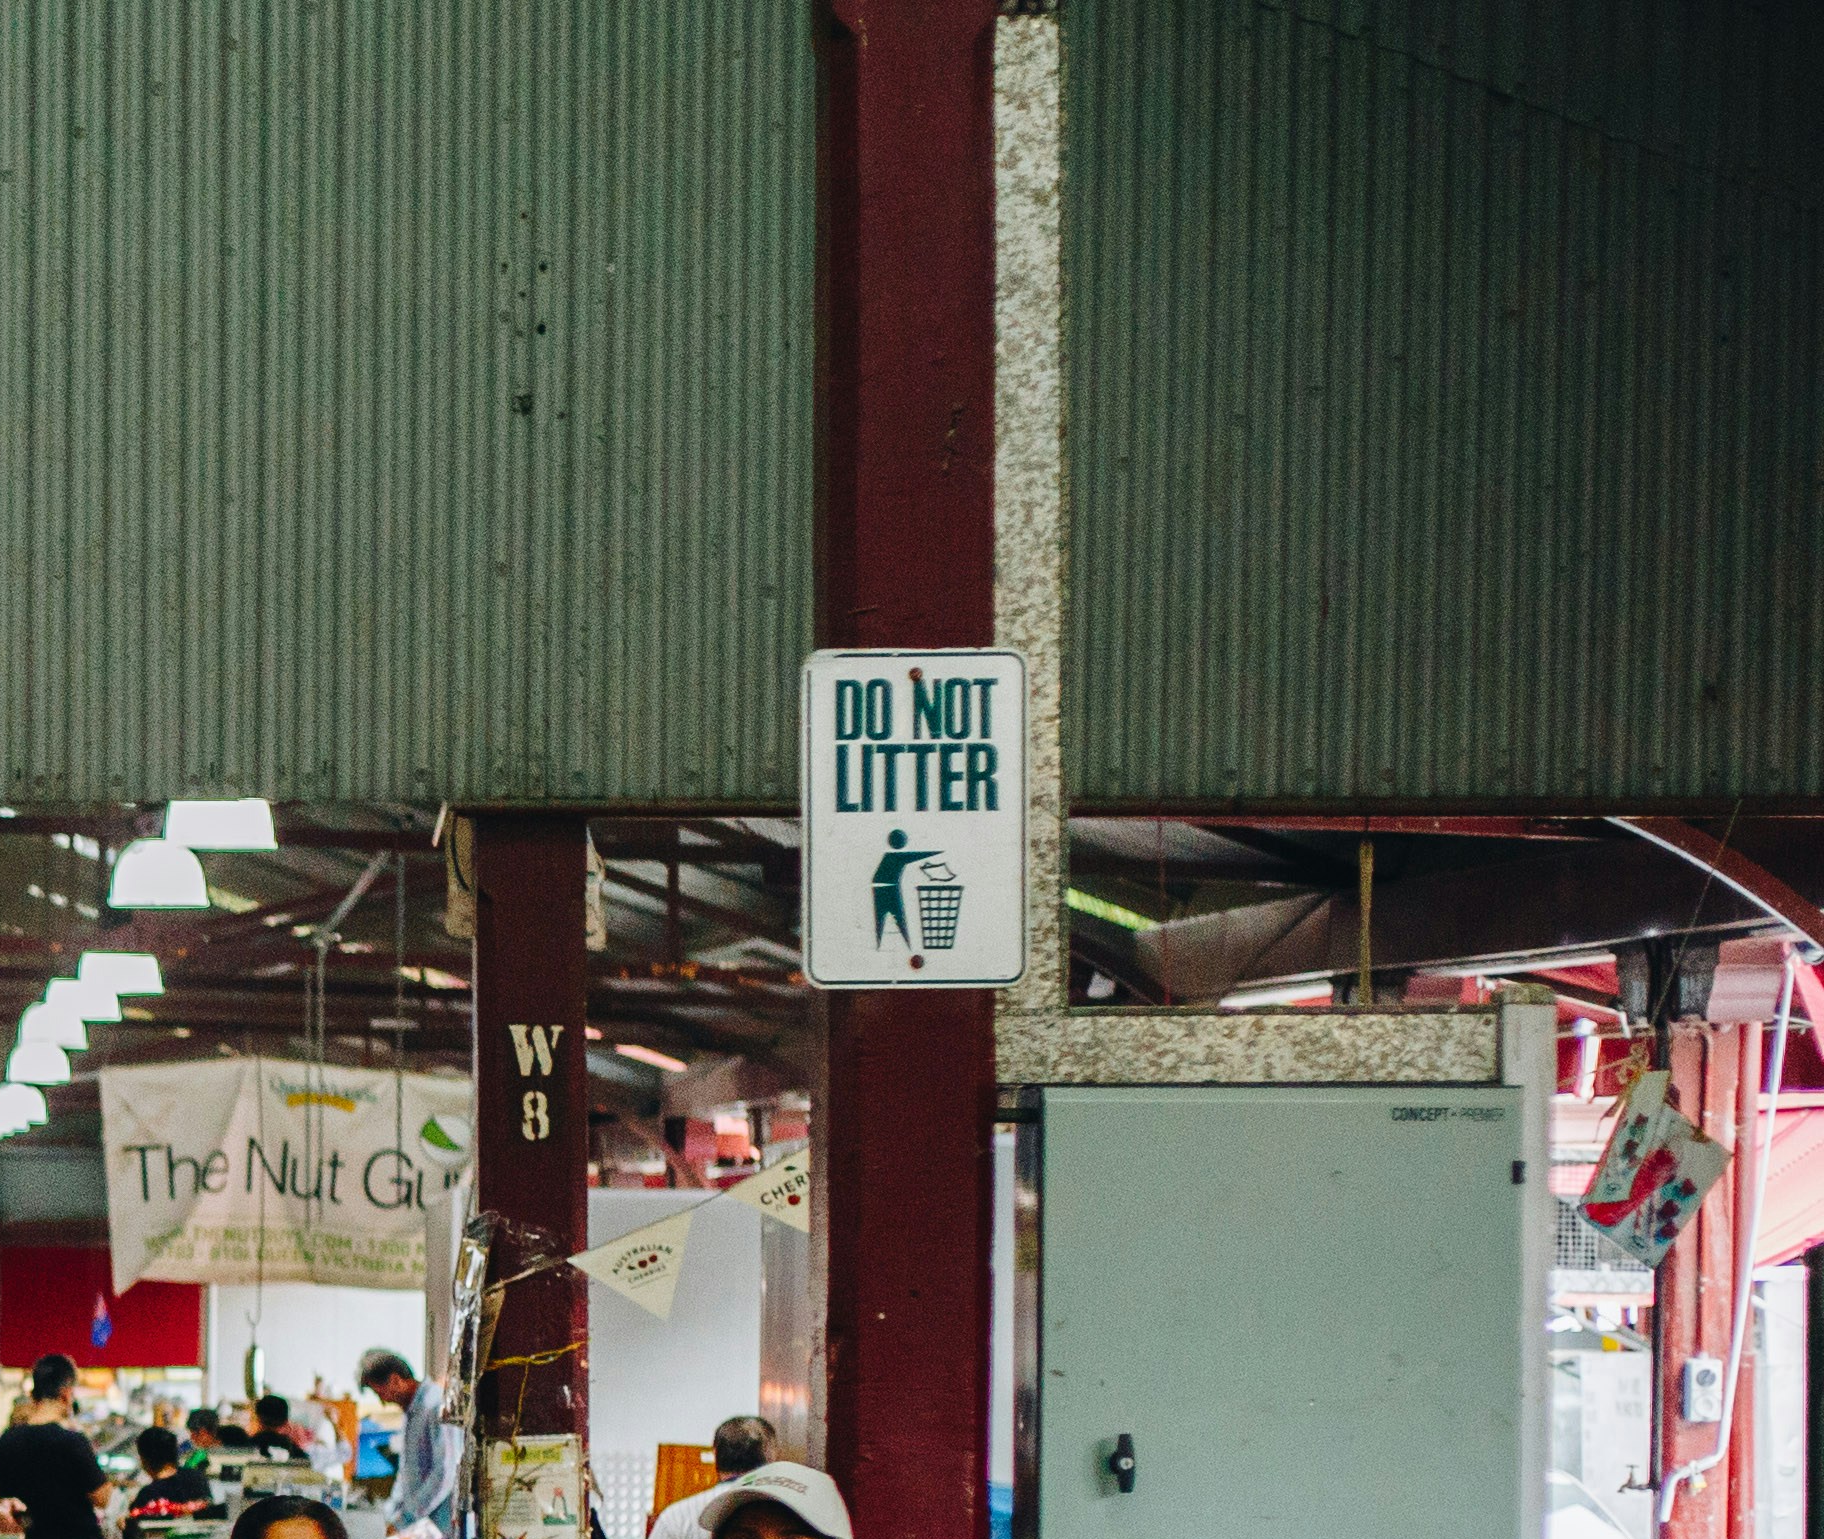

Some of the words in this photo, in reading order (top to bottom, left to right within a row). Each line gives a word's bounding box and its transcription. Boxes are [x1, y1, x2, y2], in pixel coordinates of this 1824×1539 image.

[835, 678, 894, 741] DO
[912, 677, 999, 740] NOT
[835, 743, 1000, 813] LITTER
[508, 1024, 564, 1077] W
[521, 1090, 550, 1142] 8
[1391, 1106, 1450, 1121] CONCEPT
[122, 1143, 231, 1203] The
[245, 1136, 346, 1206] Nut
[611, 1243, 674, 1275] AUSTRALIAN
